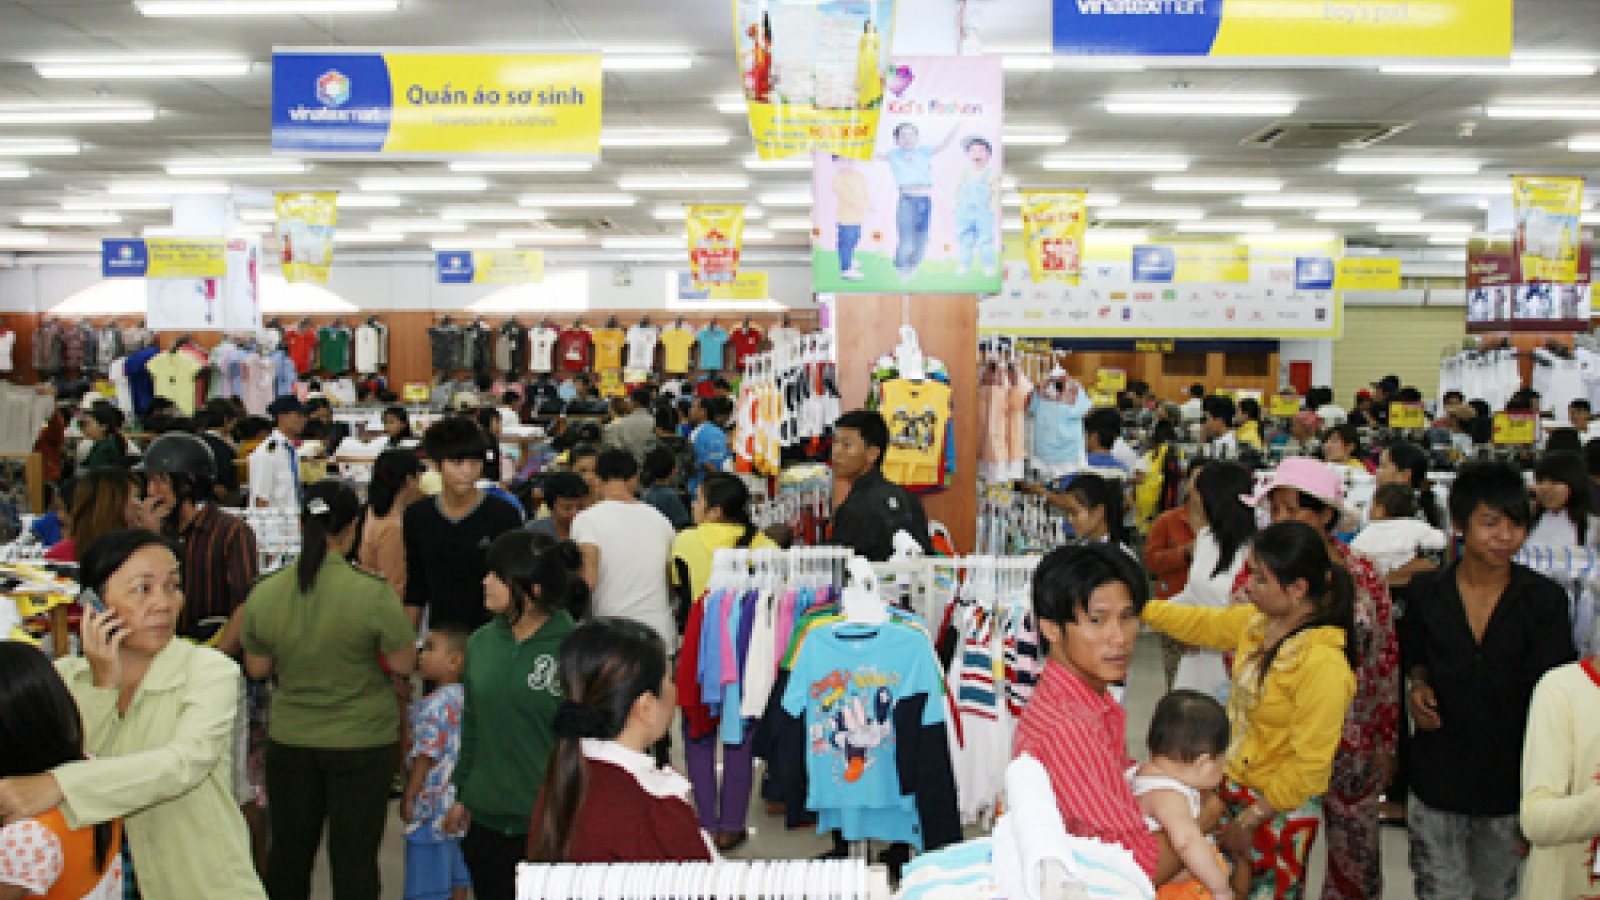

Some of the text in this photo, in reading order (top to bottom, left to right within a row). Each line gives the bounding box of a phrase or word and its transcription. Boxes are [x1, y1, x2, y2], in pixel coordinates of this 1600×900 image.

[473, 85, 500, 105] áo
[507, 87, 534, 105] sơ
[537, 85, 585, 105] sinh
